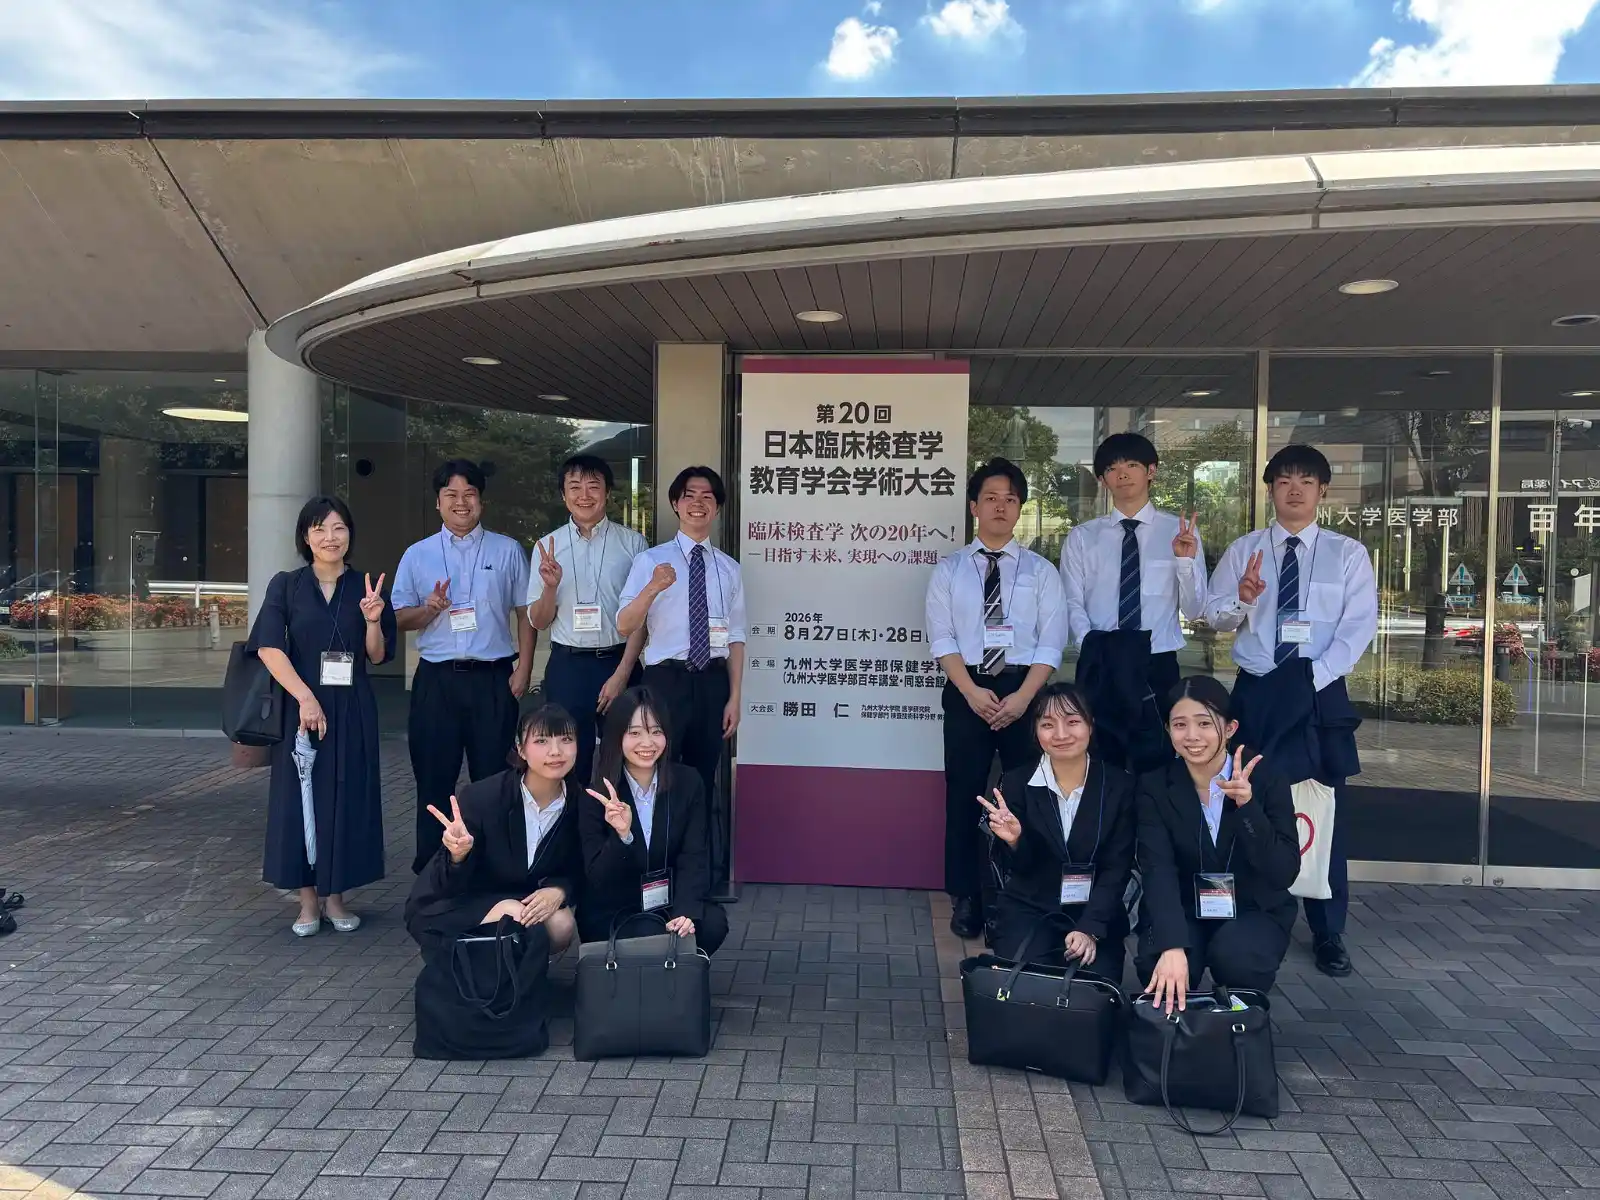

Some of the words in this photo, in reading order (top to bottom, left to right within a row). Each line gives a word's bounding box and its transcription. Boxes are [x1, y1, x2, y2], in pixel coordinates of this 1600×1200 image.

[816, 401, 892, 424] 第20回
[764, 430, 943, 460] 日本臨床検査学
[749, 465, 956, 496] 教育学会学術大会
[748, 521, 844, 541] 臨床検査学
[784, 612, 823, 624] 2026年
[750, 704, 774, 713] 大会長
